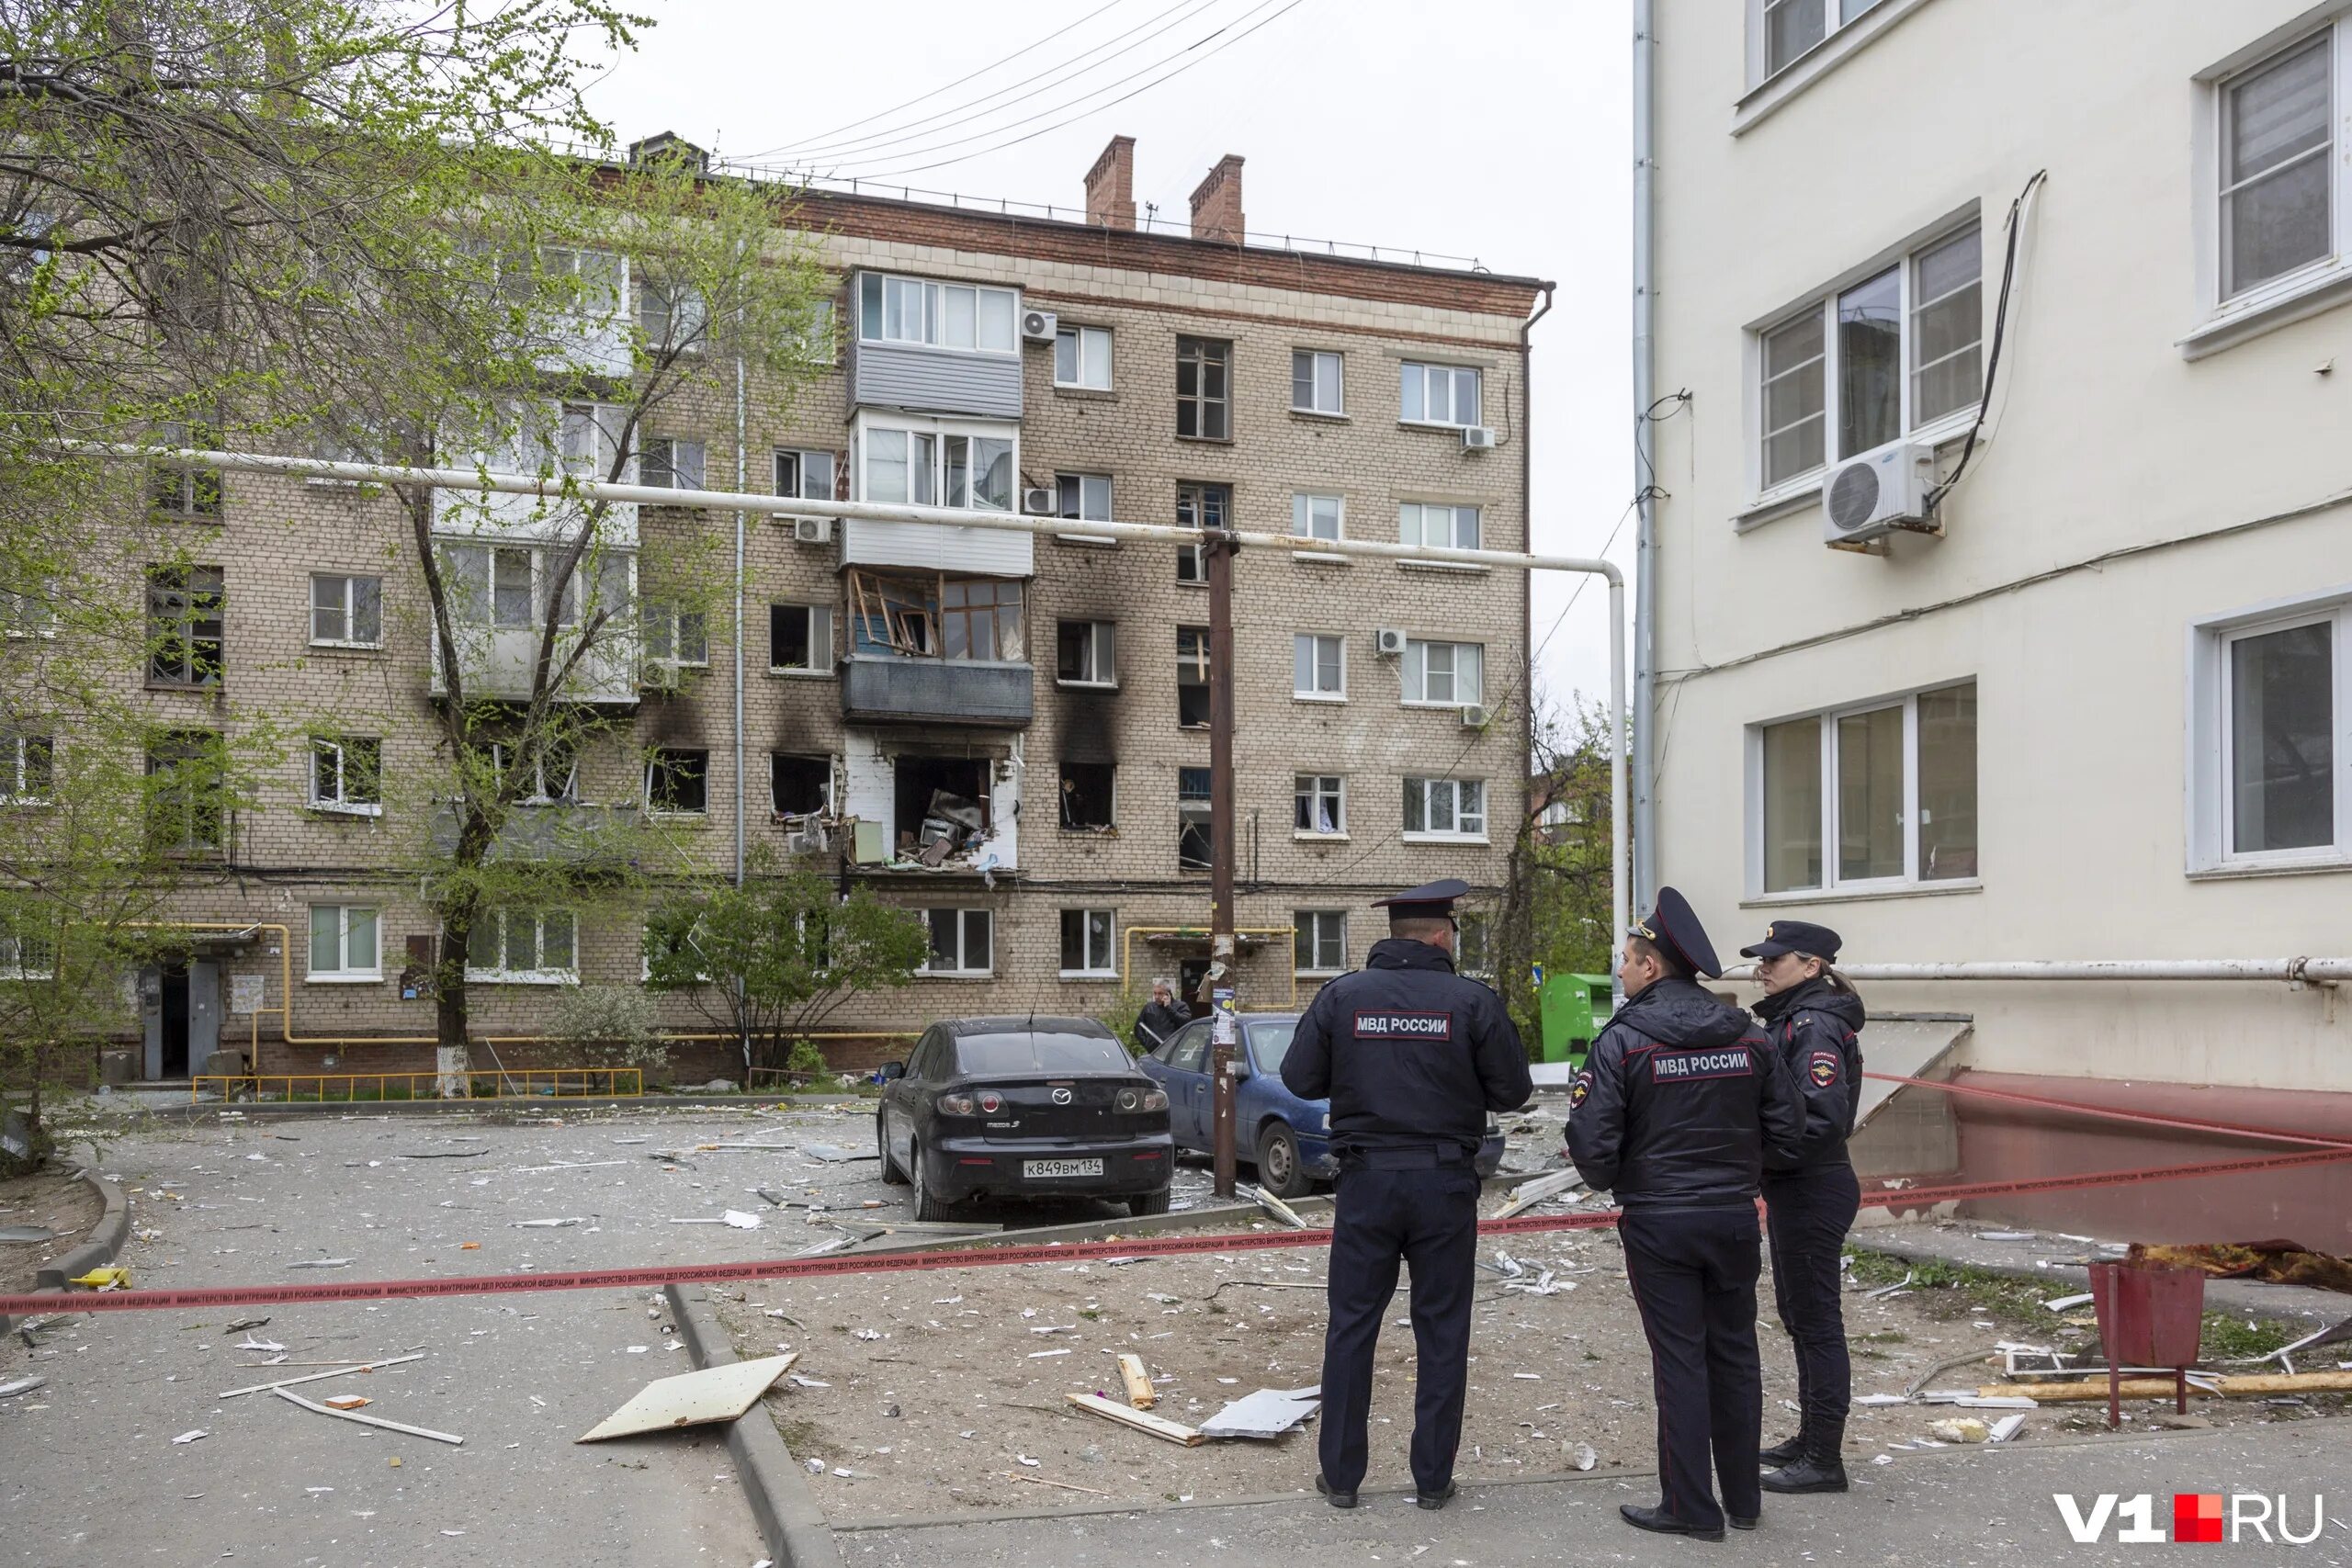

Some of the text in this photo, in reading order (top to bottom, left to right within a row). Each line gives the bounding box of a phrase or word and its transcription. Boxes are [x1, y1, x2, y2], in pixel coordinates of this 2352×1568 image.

[1357, 1017, 1447, 1032] МВД РОССИИ
[1655, 1053, 1748, 1076] МВД РОССИИ
[1028, 1159, 1102, 1175] К849ВМ 134
[176, 1293, 232, 1303] МИНИСТЕРСТВО
[234, 1292, 277, 1302] ВНУТРЕННИХ
[279, 1292, 294, 1301] ДЕЛ
[294, 1288, 340, 1299] РОССИЙСКОЙ
[342, 1288, 382, 1297] ФЕДЕРАЦИИ
[388, 1285, 438, 1295] МИНИСТЕРСТВО
[439, 1283, 480, 1293] ВНУТРЕННИХ
[481, 1282, 494, 1292] ДЕЛ
[495, 1280, 537, 1290] РОССИЙСКОЙ
[538, 1279, 575, 1288] ФЕДЕРАЦИИ
[580, 1275, 627, 1285] МИНИСТЕРСТВО
[628, 1273, 665, 1282] ВНУТРЕННИХ
[665, 1272, 678, 1280] ДЕЛ
[679, 1269, 717, 1280] РОССИЙСКОЙ
[718, 1268, 752, 1278] ФЕДЕРАЦИИ
[757, 1264, 801, 1275] МИНИСТЕРСТВО
[801, 1263, 836, 1272] ВНУТРЕННИХ
[837, 1262, 848, 1271] ДЕЛ
[849, 1258, 886, 1269] РОССИЙСКОЙ
[886, 1258, 918, 1268] ФЕДЕРАЦИИ
[922, 1255, 963, 1265] МИНИСТЕРСТВО
[965, 1253, 998, 1262] ВНУТРЕННИХ
[998, 1252, 1009, 1261] ДЕЛ
[1010, 1249, 1044, 1259] РОССИЙСКОЙ
[1044, 1248, 1075, 1258] ФЕДЕРАЦИИ
[1079, 1246, 1117, 1256] МИНИСТЕРСТВО
[1119, 1244, 1150, 1254] ВНУТРЕННИХ
[1161, 1240, 1194, 1251] РОССИЙСКОЙ
[1194, 1239, 1224, 1248] ФЕДЕРАЦИИ
[1227, 1237, 1266, 1247] МИНИСТЕРСТВО
[1266, 1235, 1297, 1245] ВНУТРЕННИХ
[1297, 1235, 1306, 1243] ДЕЛ
